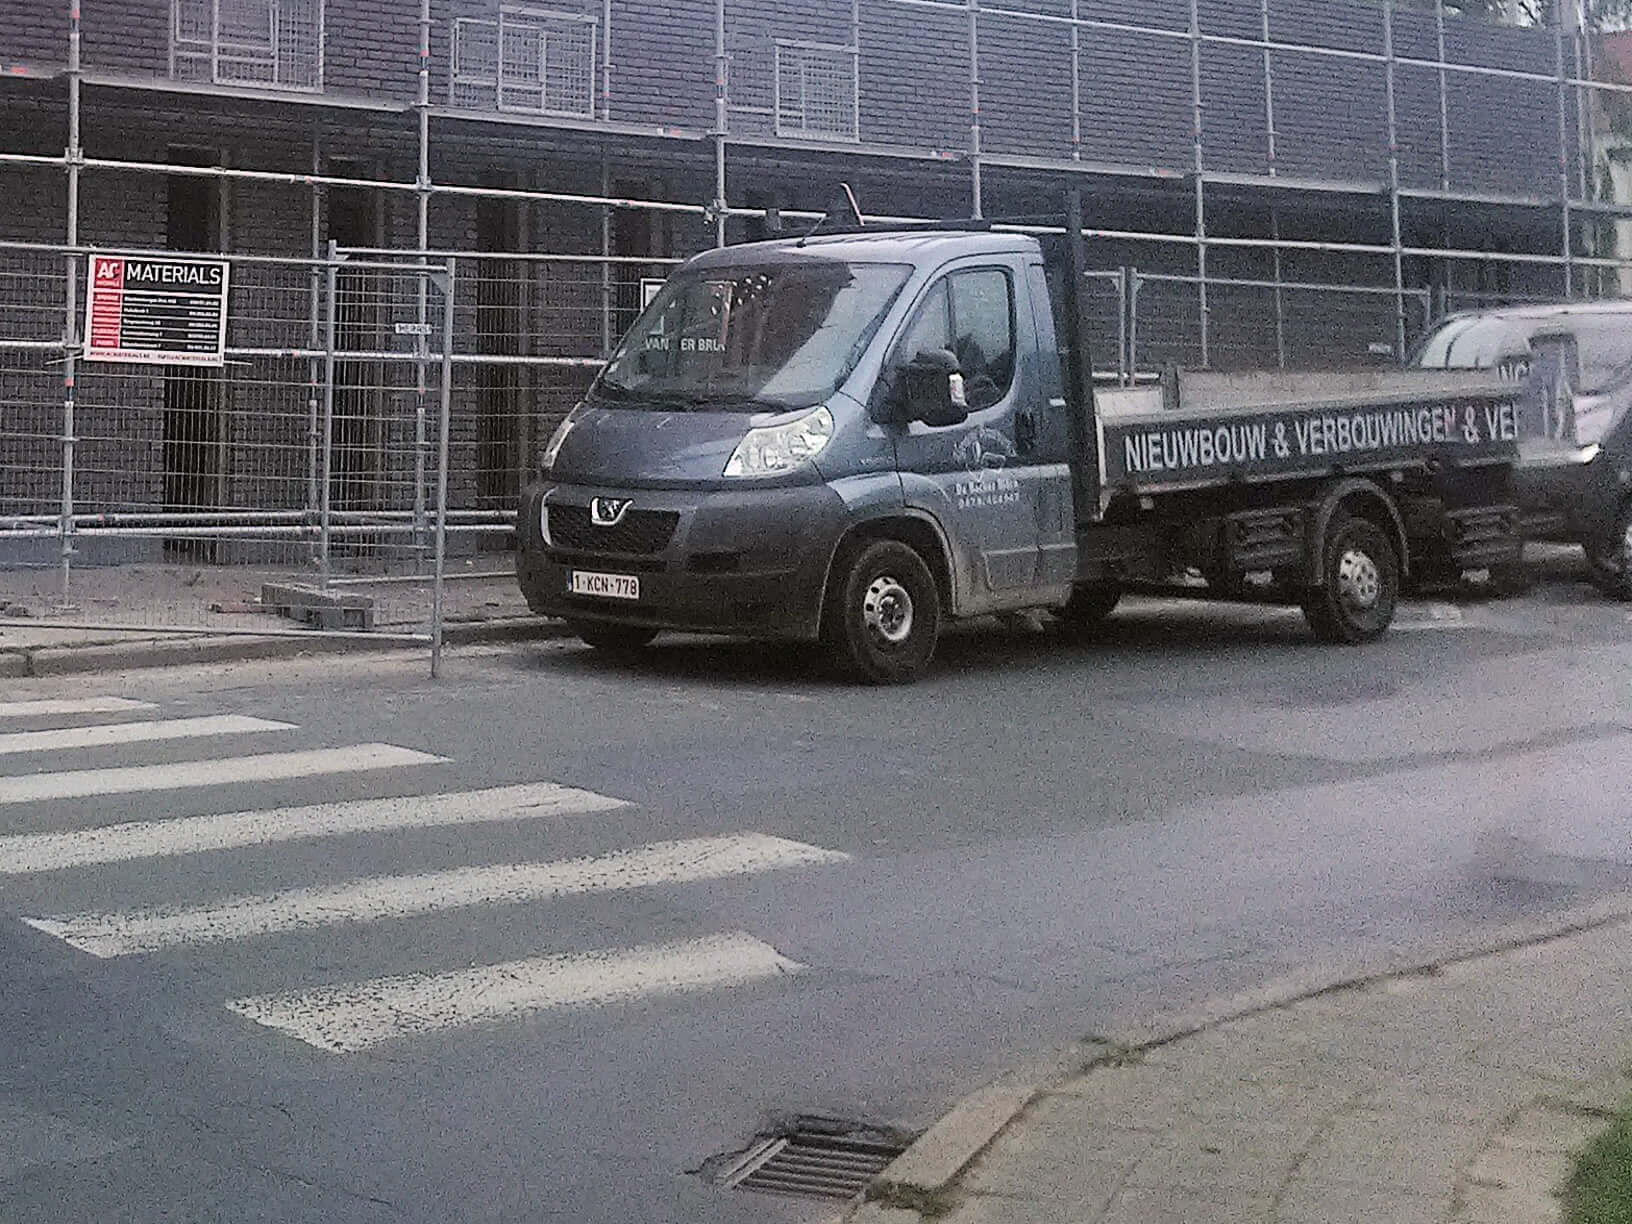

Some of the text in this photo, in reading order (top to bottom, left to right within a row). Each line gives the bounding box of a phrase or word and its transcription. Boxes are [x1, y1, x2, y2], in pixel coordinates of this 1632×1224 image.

[126, 262, 221, 285] MATERIALS
[645, 338, 670, 351] VAN
[1124, 424, 1266, 472] NIEUWBOUW
[1273, 421, 1291, 458] &
[1294, 406, 1456, 456] VERBOUWINGEN
[1463, 405, 1480, 444] &
[574, 574, 638, 596] 1-KCN-778
